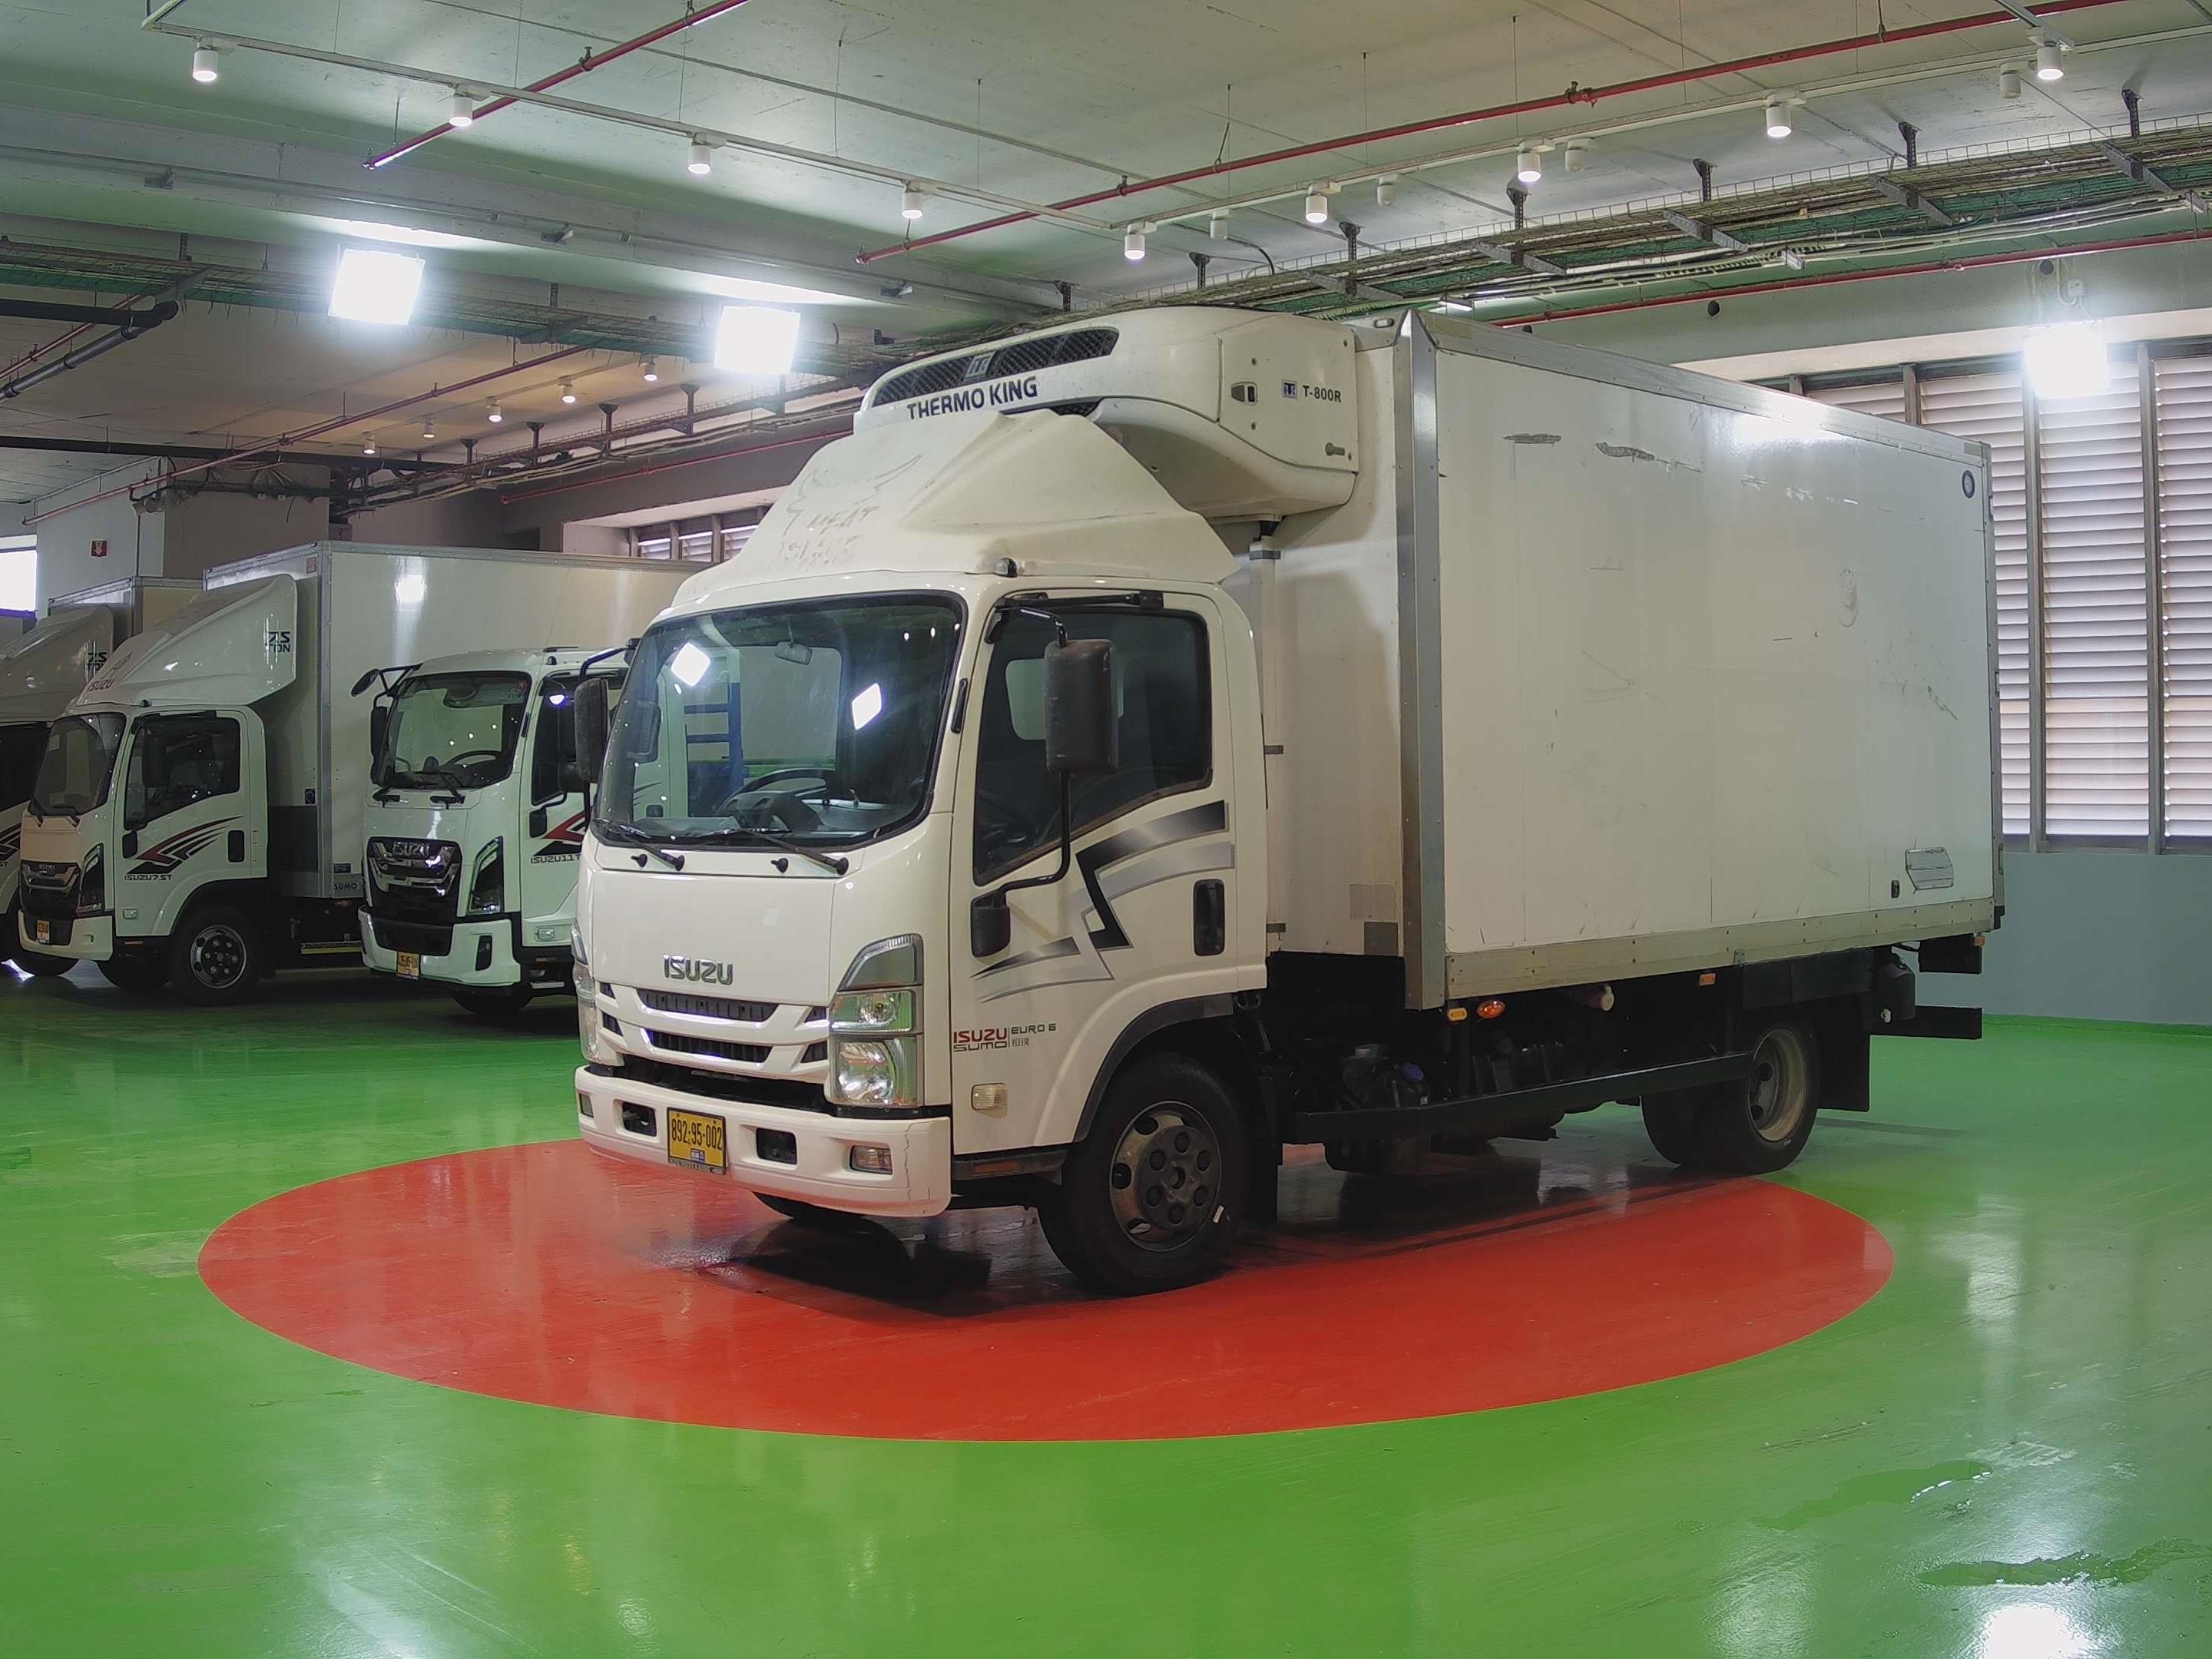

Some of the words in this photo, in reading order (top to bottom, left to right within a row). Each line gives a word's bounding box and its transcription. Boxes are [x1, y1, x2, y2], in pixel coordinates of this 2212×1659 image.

[906, 387, 985, 420] THERMO
[989, 375, 1038, 406] KING
[1302, 384, 1342, 403] T-800R
[333, 882, 357, 891] SUMO
[663, 954, 733, 985] ISUZU
[953, 1027, 1008, 1044] ISUZU
[1011, 1025, 1045, 1035] EURO
[1048, 1023, 1057, 1031] 6
[953, 1041, 1008, 1052] SUMO
